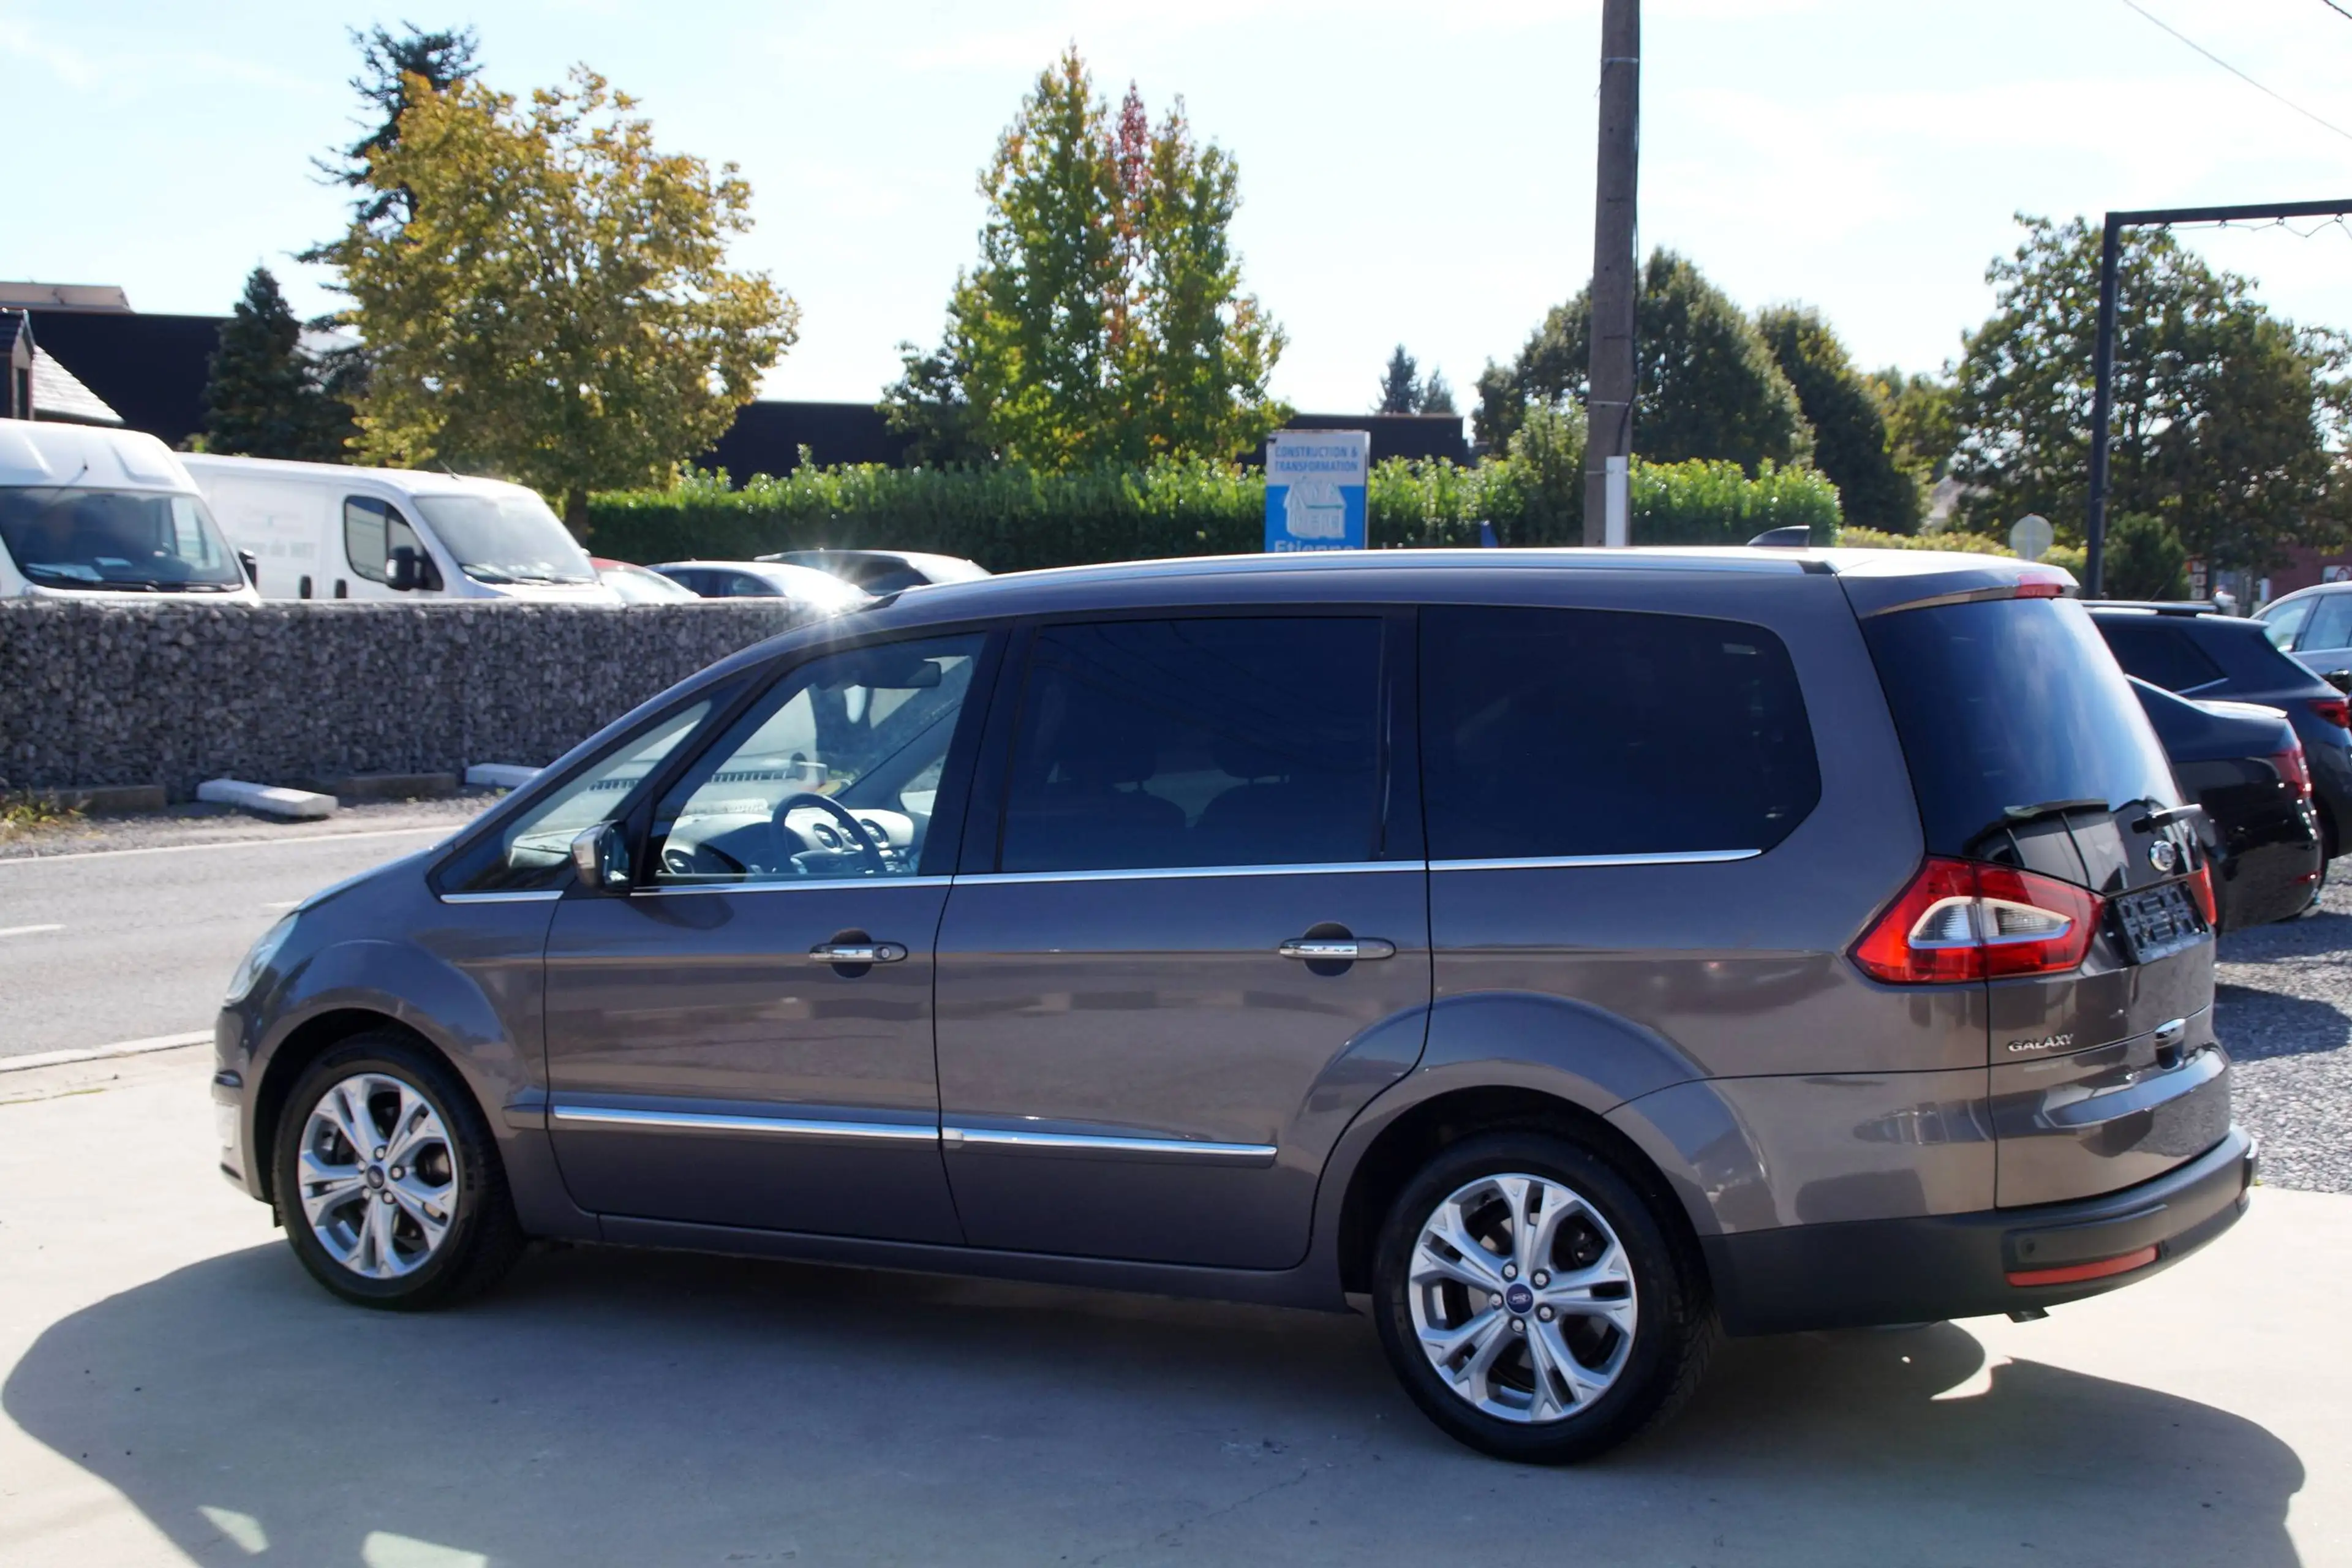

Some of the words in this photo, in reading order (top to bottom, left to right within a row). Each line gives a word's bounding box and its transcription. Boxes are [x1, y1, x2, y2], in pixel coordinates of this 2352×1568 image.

[1275, 445, 1347, 458] CONSTRUCTION
[1275, 461, 1359, 472] TRANSFORMATION
[2008, 1033, 2074, 1052] GALAXY
